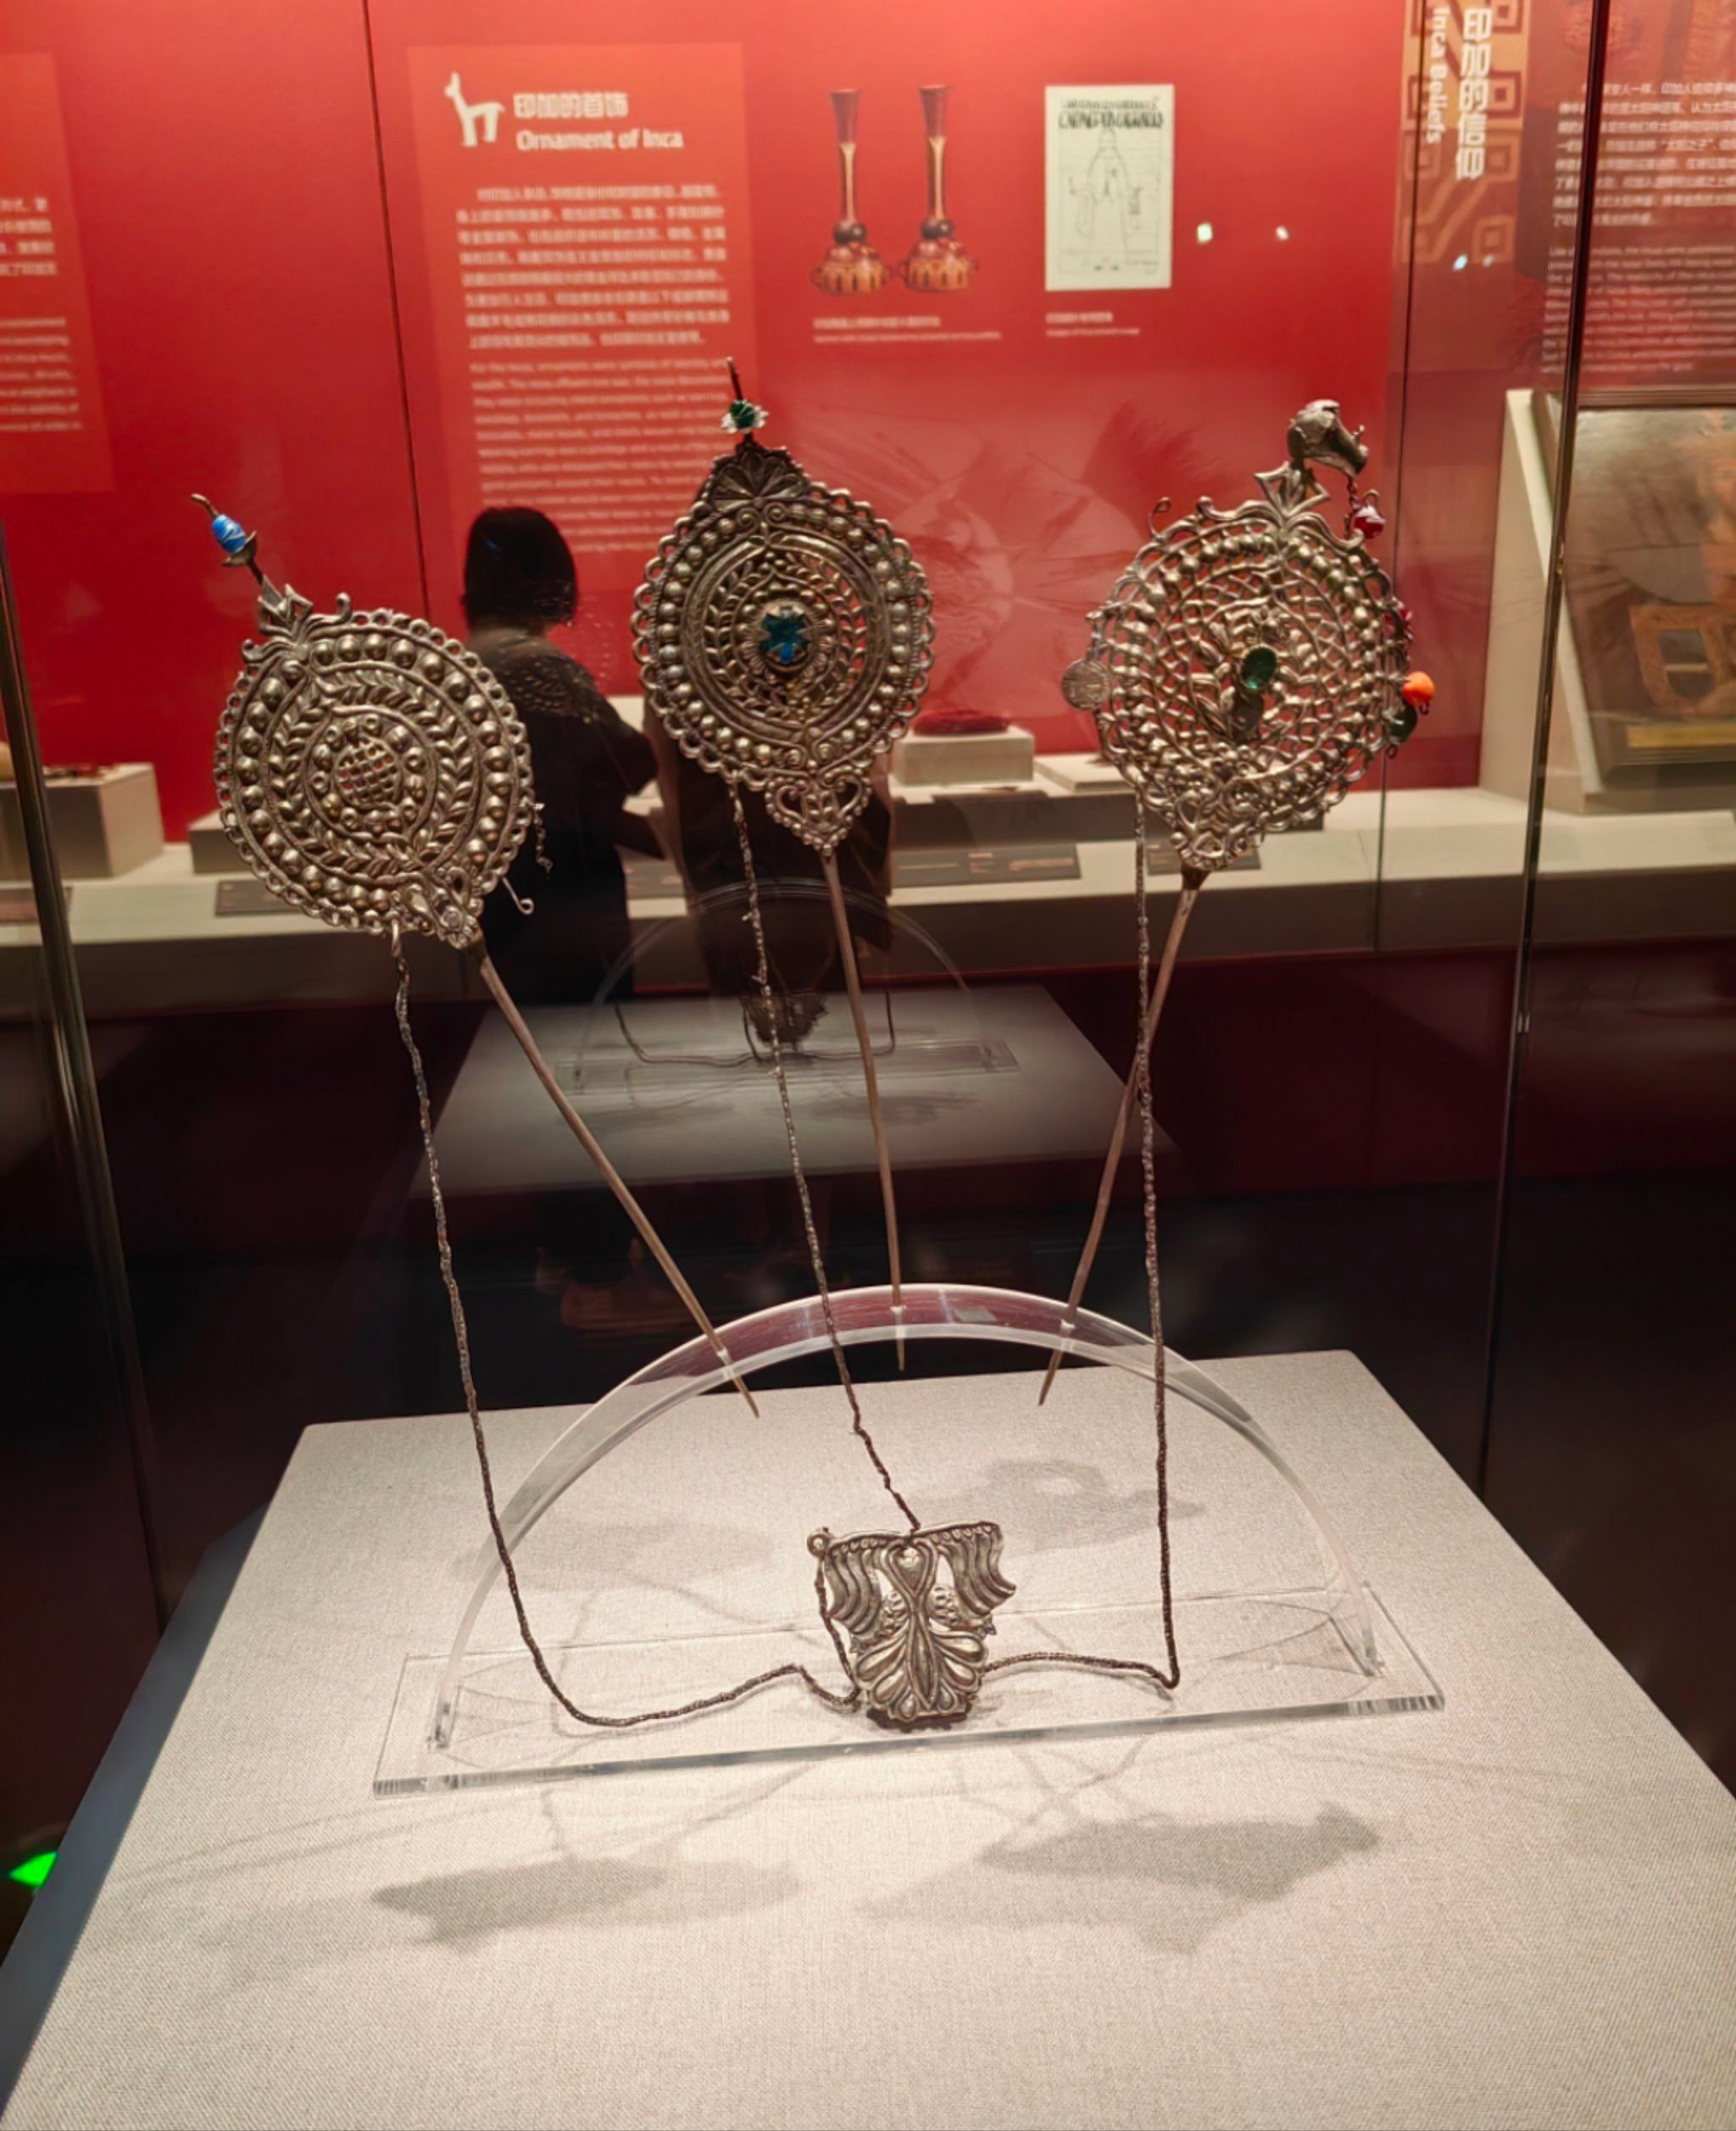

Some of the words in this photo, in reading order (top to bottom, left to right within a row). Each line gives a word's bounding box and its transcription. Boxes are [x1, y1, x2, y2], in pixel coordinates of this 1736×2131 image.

[1430, 7, 1450, 58] Inca
[513, 92, 629, 120] 印加的首饰
[1426, 63, 1449, 144] Beliefs
[1455, 8, 1493, 181] 印加的信仰
[515, 129, 615, 151] Ornament
[617, 128, 641, 149] of
[642, 127, 684, 149] Inca
